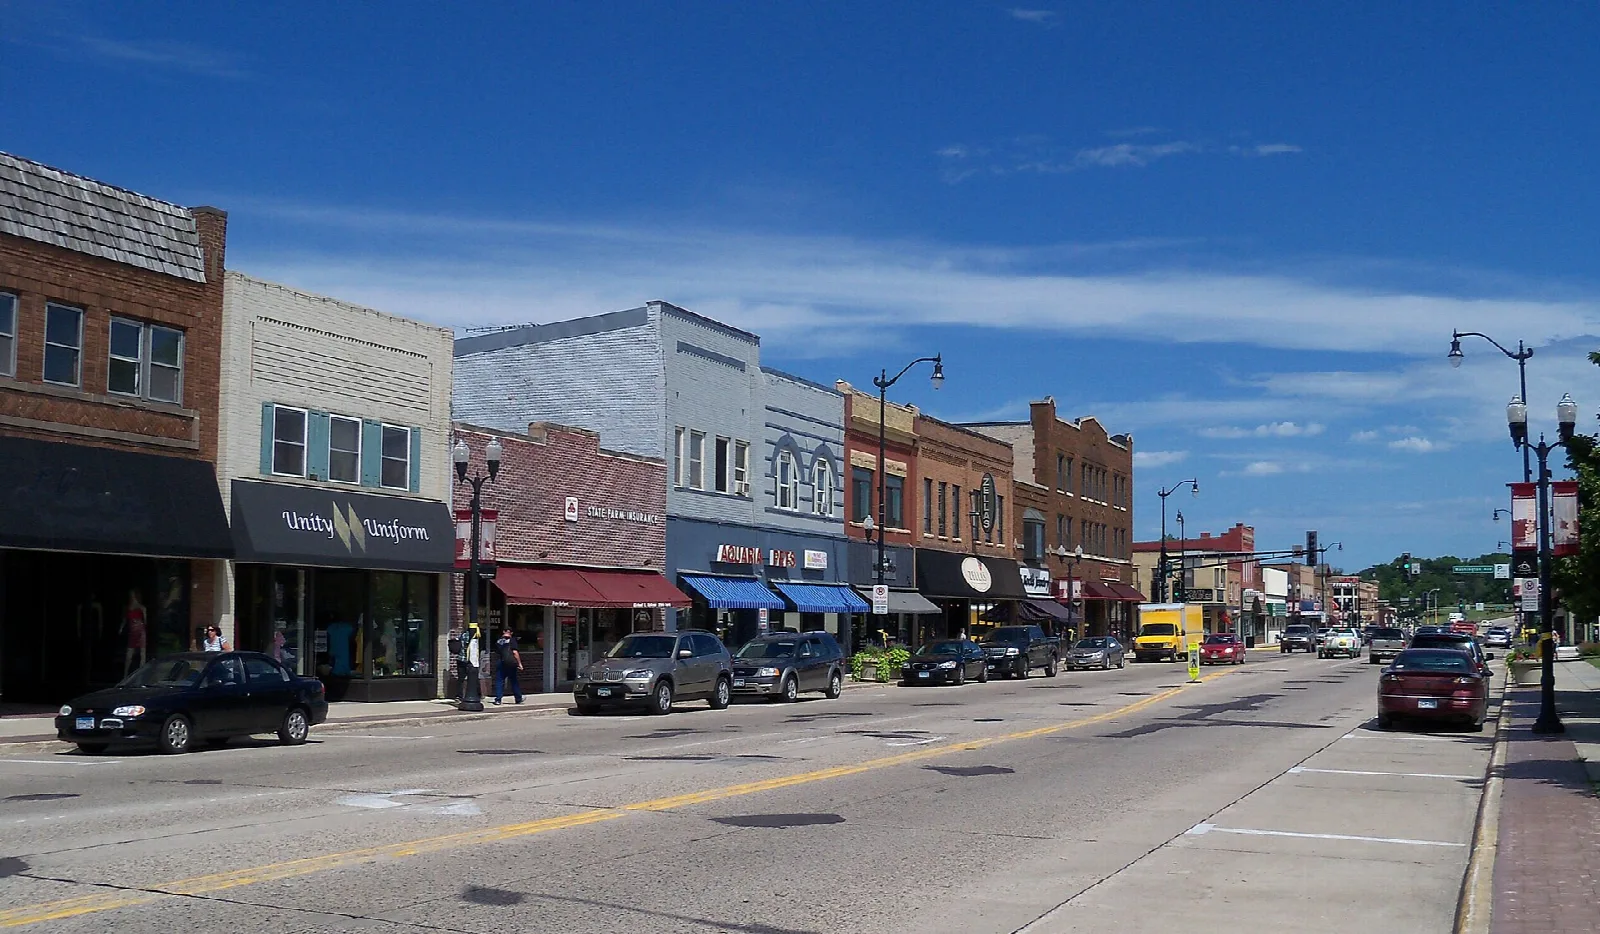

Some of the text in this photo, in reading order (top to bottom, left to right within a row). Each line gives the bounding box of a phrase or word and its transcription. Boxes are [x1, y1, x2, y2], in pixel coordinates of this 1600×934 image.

[587, 506, 659, 524] STATE FARM INSURANCE
[982, 477, 990, 529] ZELLAS
[282, 511, 430, 544] Unity Uniform
[717, 544, 764, 564] AQUARIA
[769, 549, 796, 568] PETS
